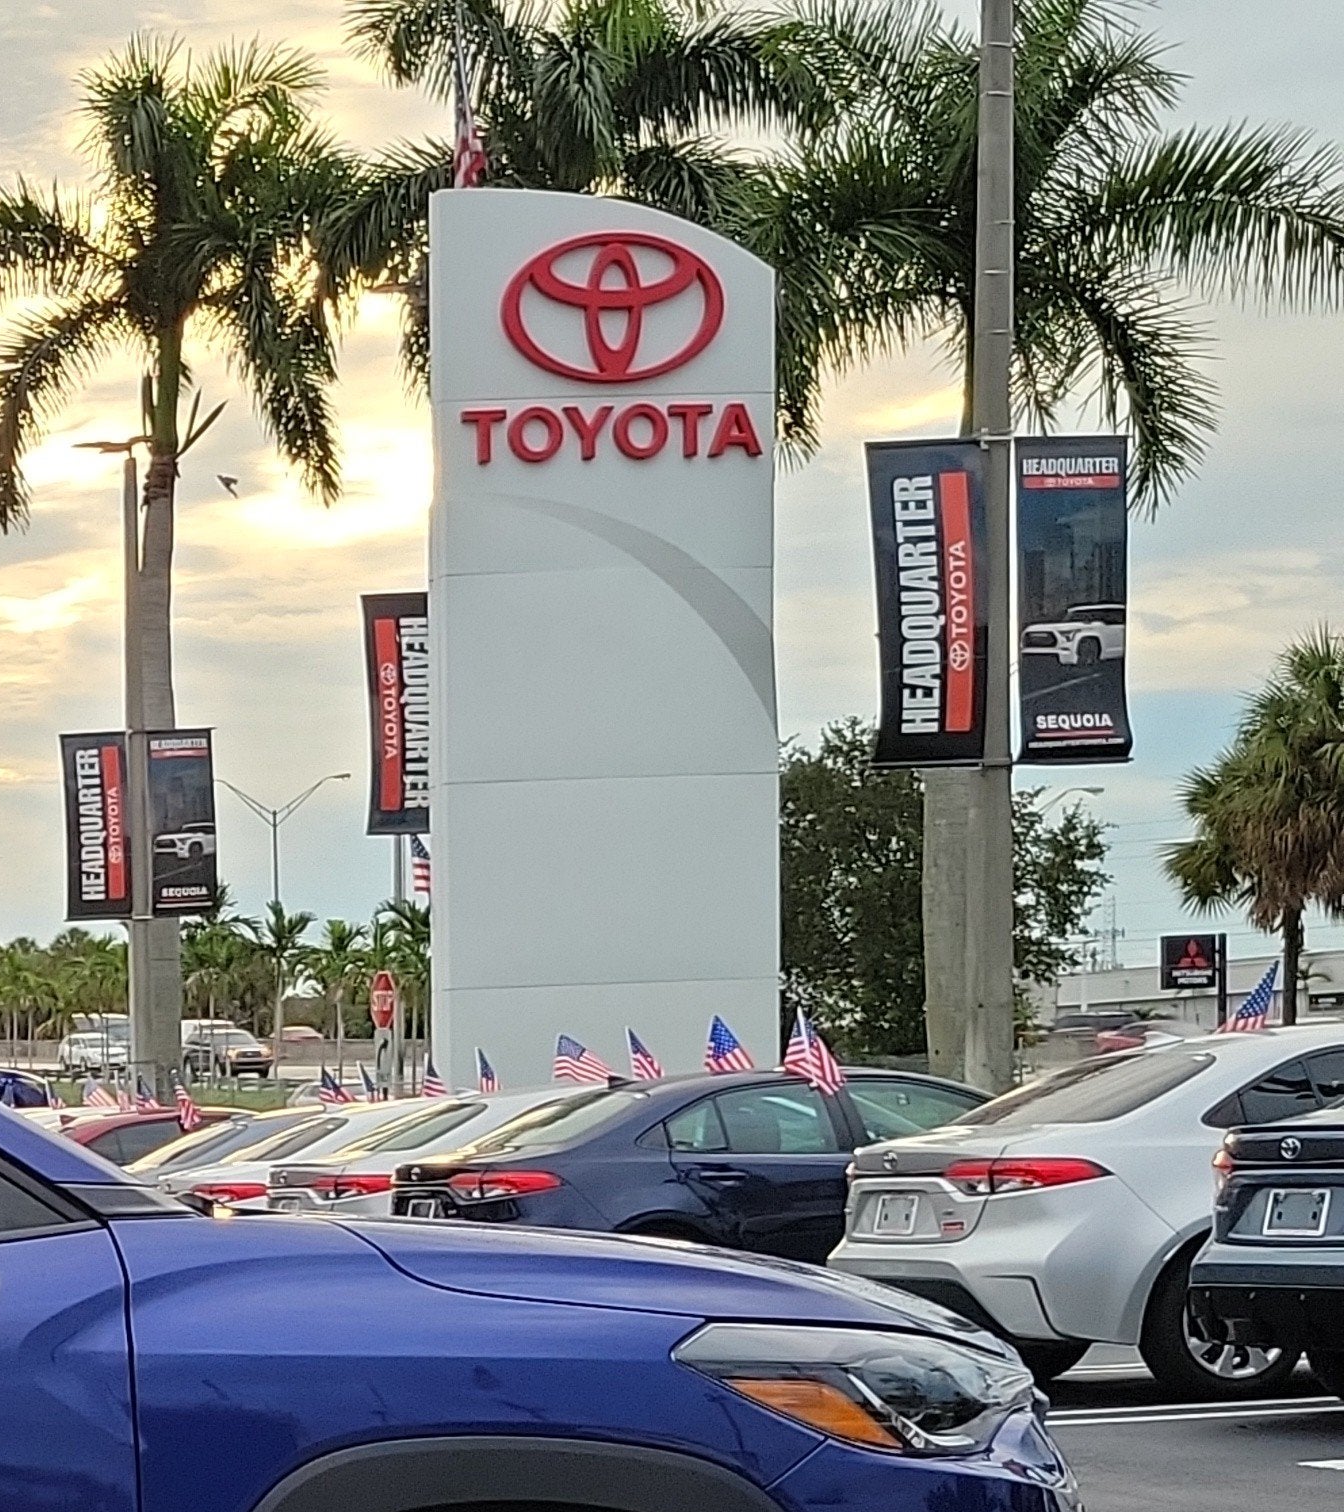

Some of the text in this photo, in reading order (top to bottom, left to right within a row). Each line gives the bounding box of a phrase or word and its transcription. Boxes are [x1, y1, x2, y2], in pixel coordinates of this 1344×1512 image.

[461, 403, 762, 465] TOYOTA
[1023, 457, 1119, 477] HEADQUARTER
[893, 475, 945, 734] HEADQUARTER
[949, 540, 968, 638] TOYOTA
[383, 687, 399, 760] TOYOTA
[399, 617, 429, 809] HEADQUARTER
[1036, 713, 1114, 730] SEQUOIA
[76, 749, 107, 901] HEADQUARTER
[107, 787, 122, 845] TOYOTA
[161, 886, 209, 898] SEQUOIA
